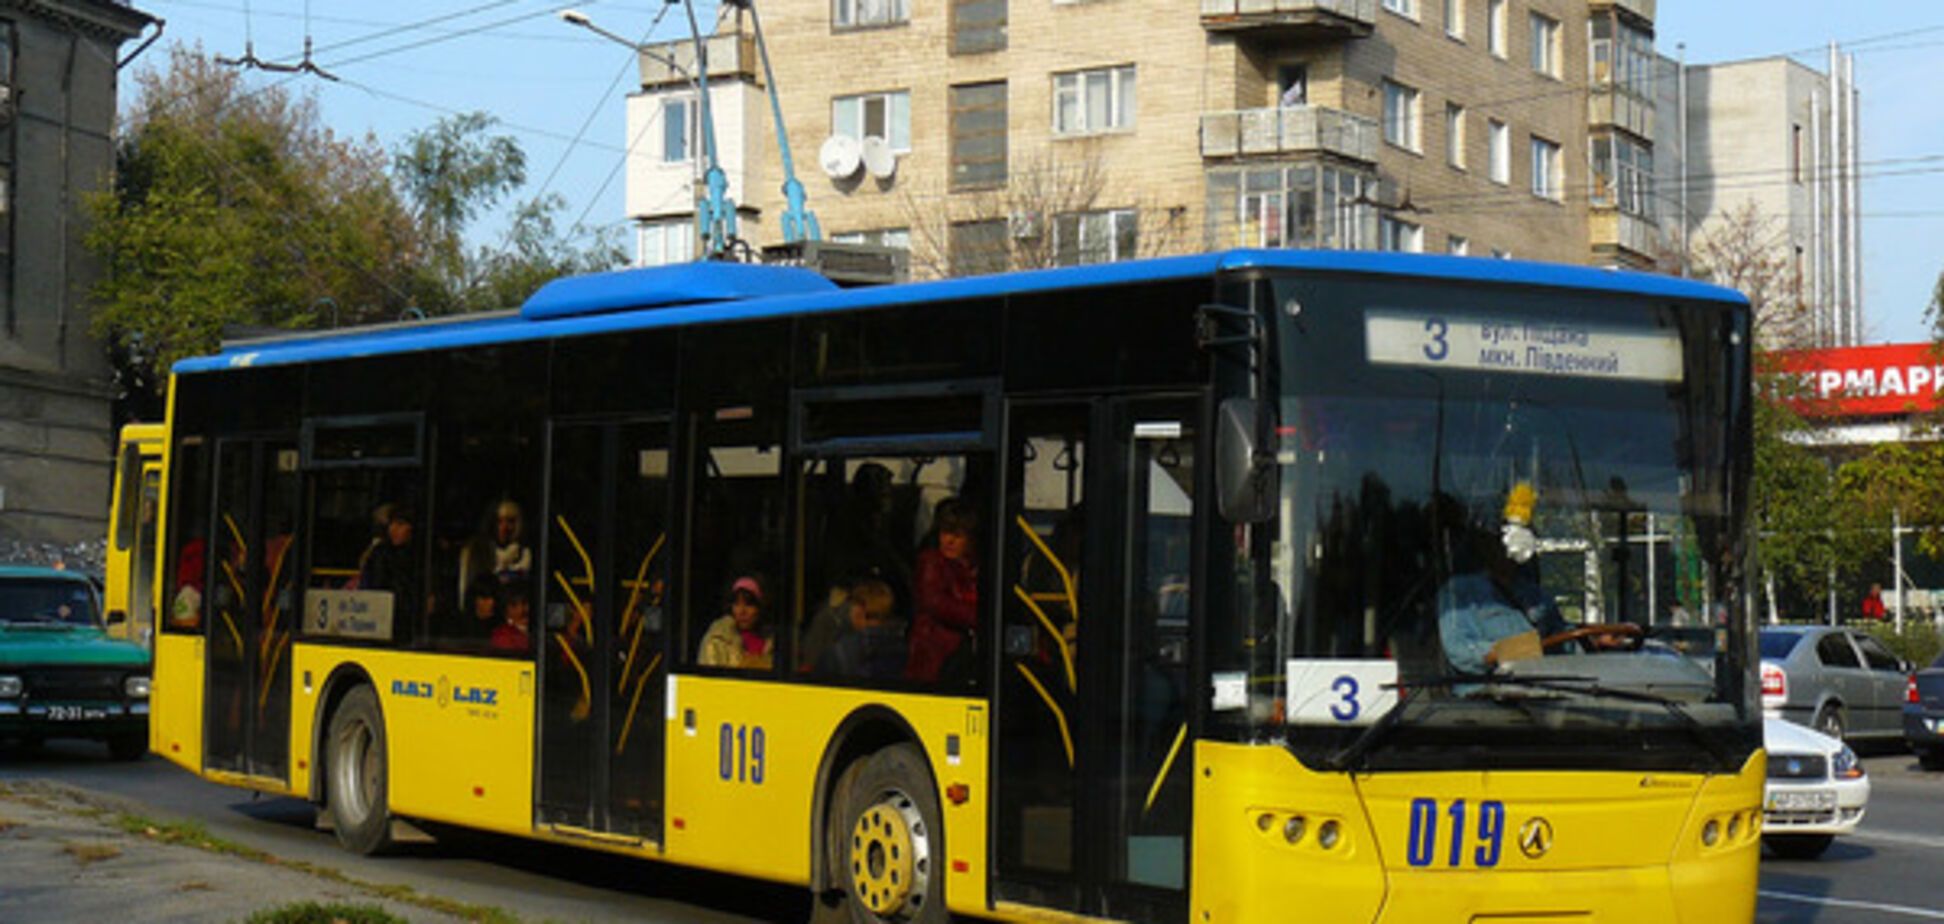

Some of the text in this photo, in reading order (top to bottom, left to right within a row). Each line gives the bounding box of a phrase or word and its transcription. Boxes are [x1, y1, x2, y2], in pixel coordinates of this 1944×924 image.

[1423, 316, 1449, 361] 3
[1525, 346, 1618, 373] Південний
[1330, 675, 1360, 721] 3
[719, 723, 765, 784] 019
[1406, 797, 1505, 867] 019
